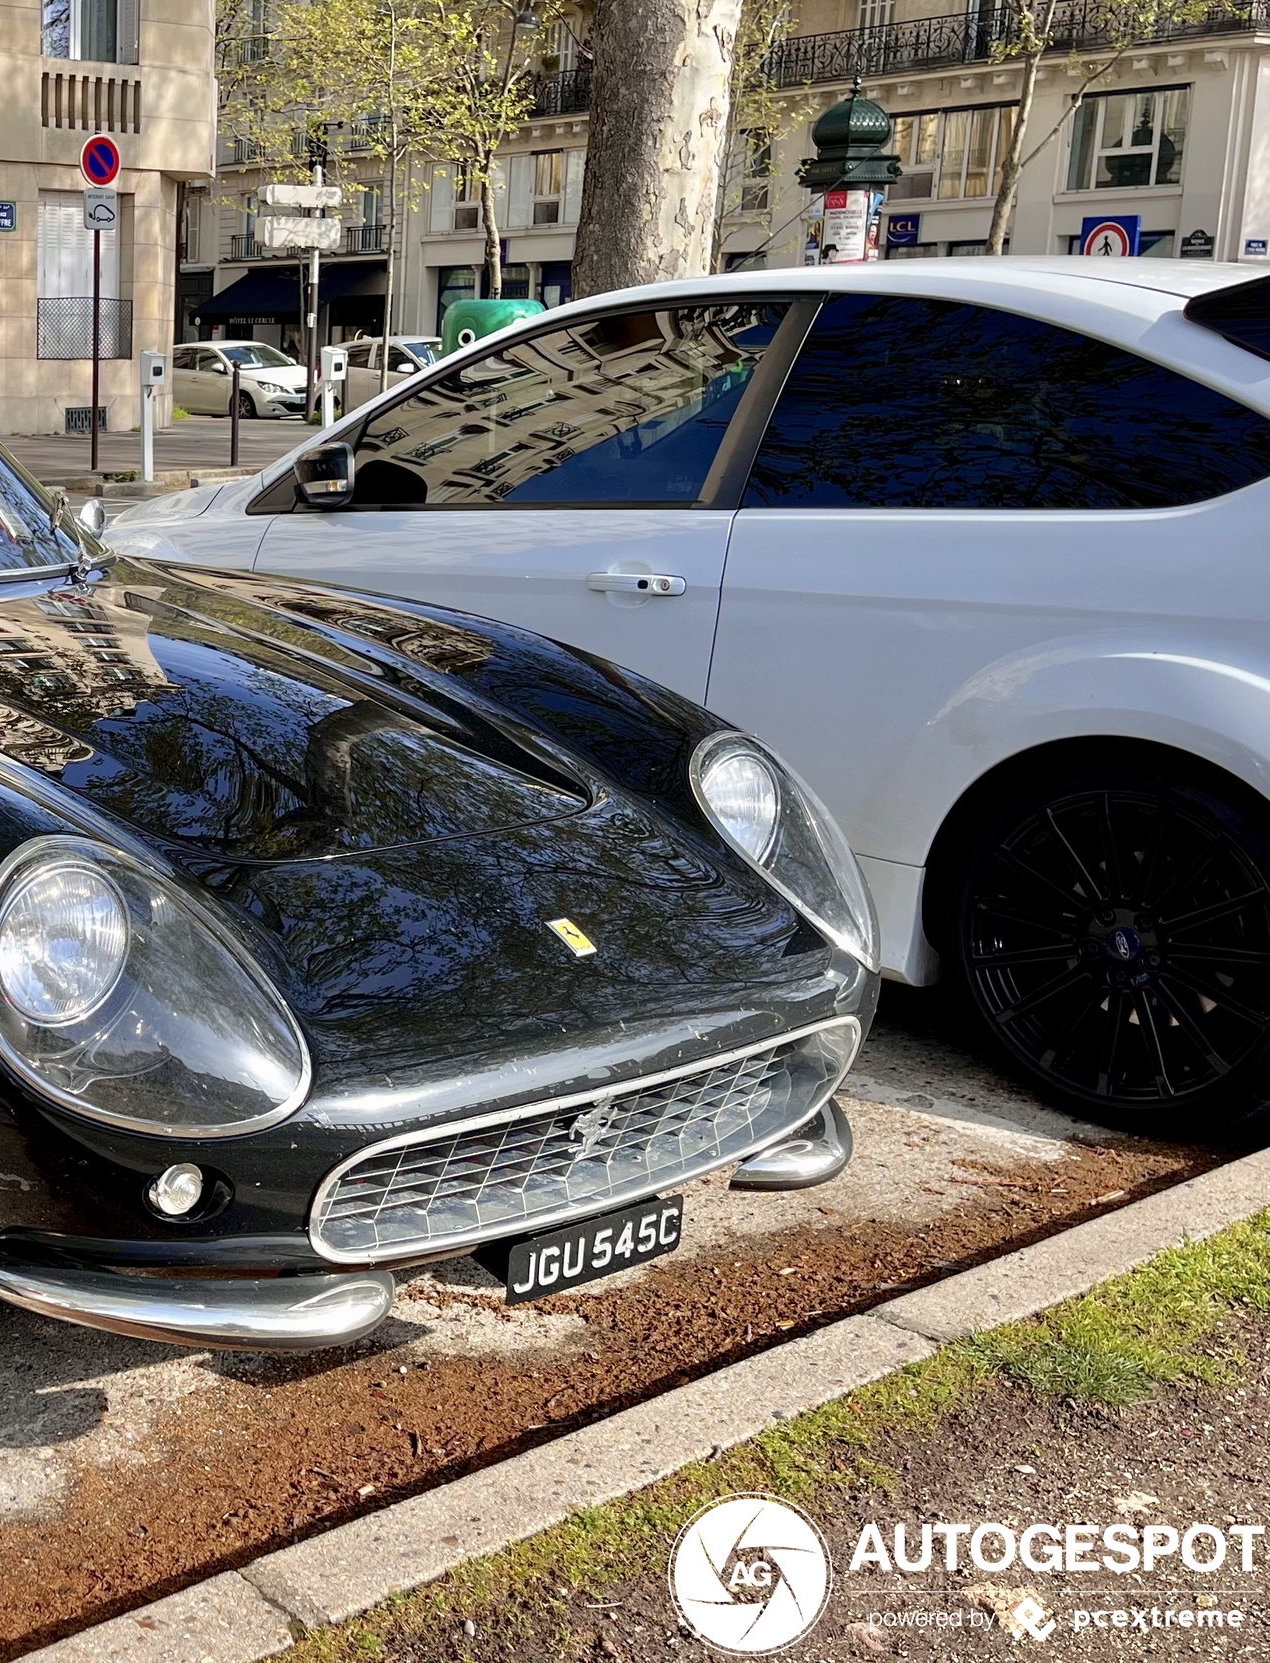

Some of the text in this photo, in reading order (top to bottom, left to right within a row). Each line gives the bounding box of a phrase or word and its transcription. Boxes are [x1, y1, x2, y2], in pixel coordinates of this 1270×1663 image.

[890, 221, 916, 232] LCL
[513, 1208, 680, 1294] JGU 545C
